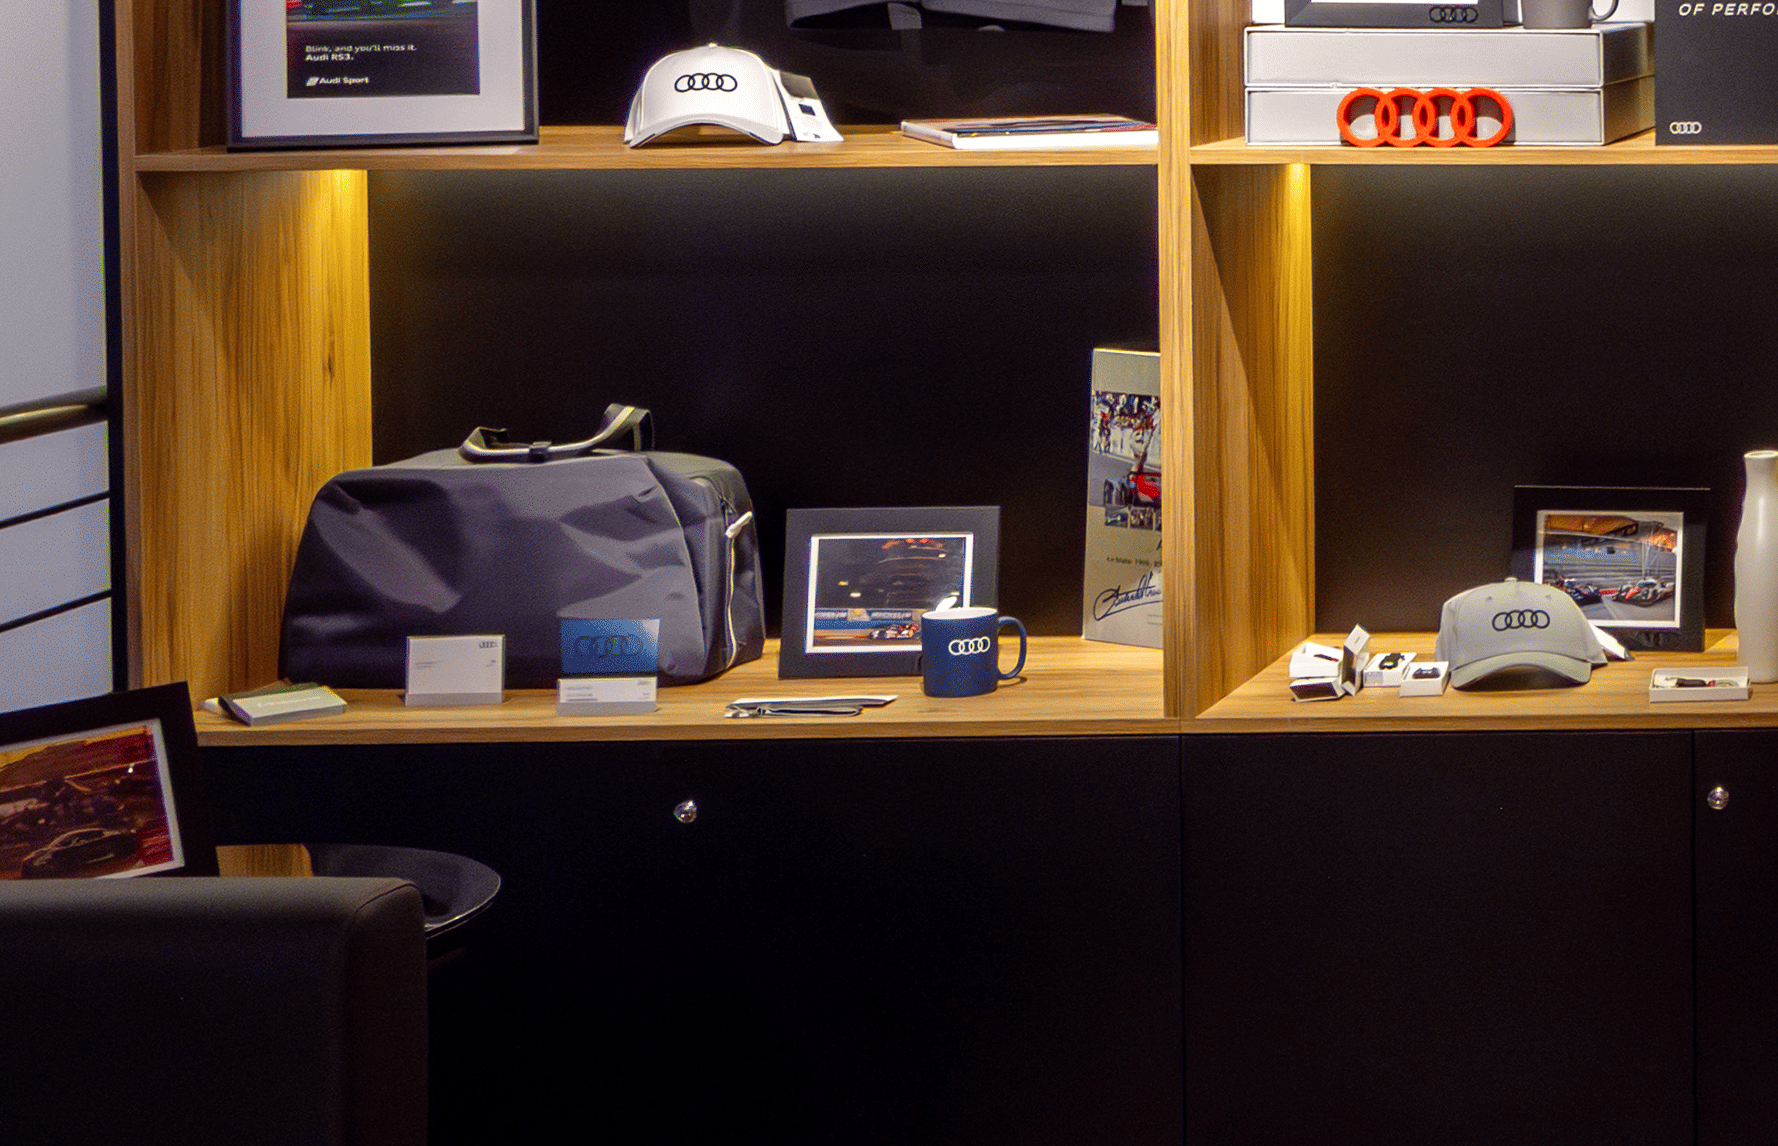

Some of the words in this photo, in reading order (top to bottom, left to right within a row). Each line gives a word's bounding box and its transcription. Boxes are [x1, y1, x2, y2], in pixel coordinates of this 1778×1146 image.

[1678, 3, 1705, 16] OF
[305, 53, 329, 61] Audi
[343, 76, 369, 85] Sport
